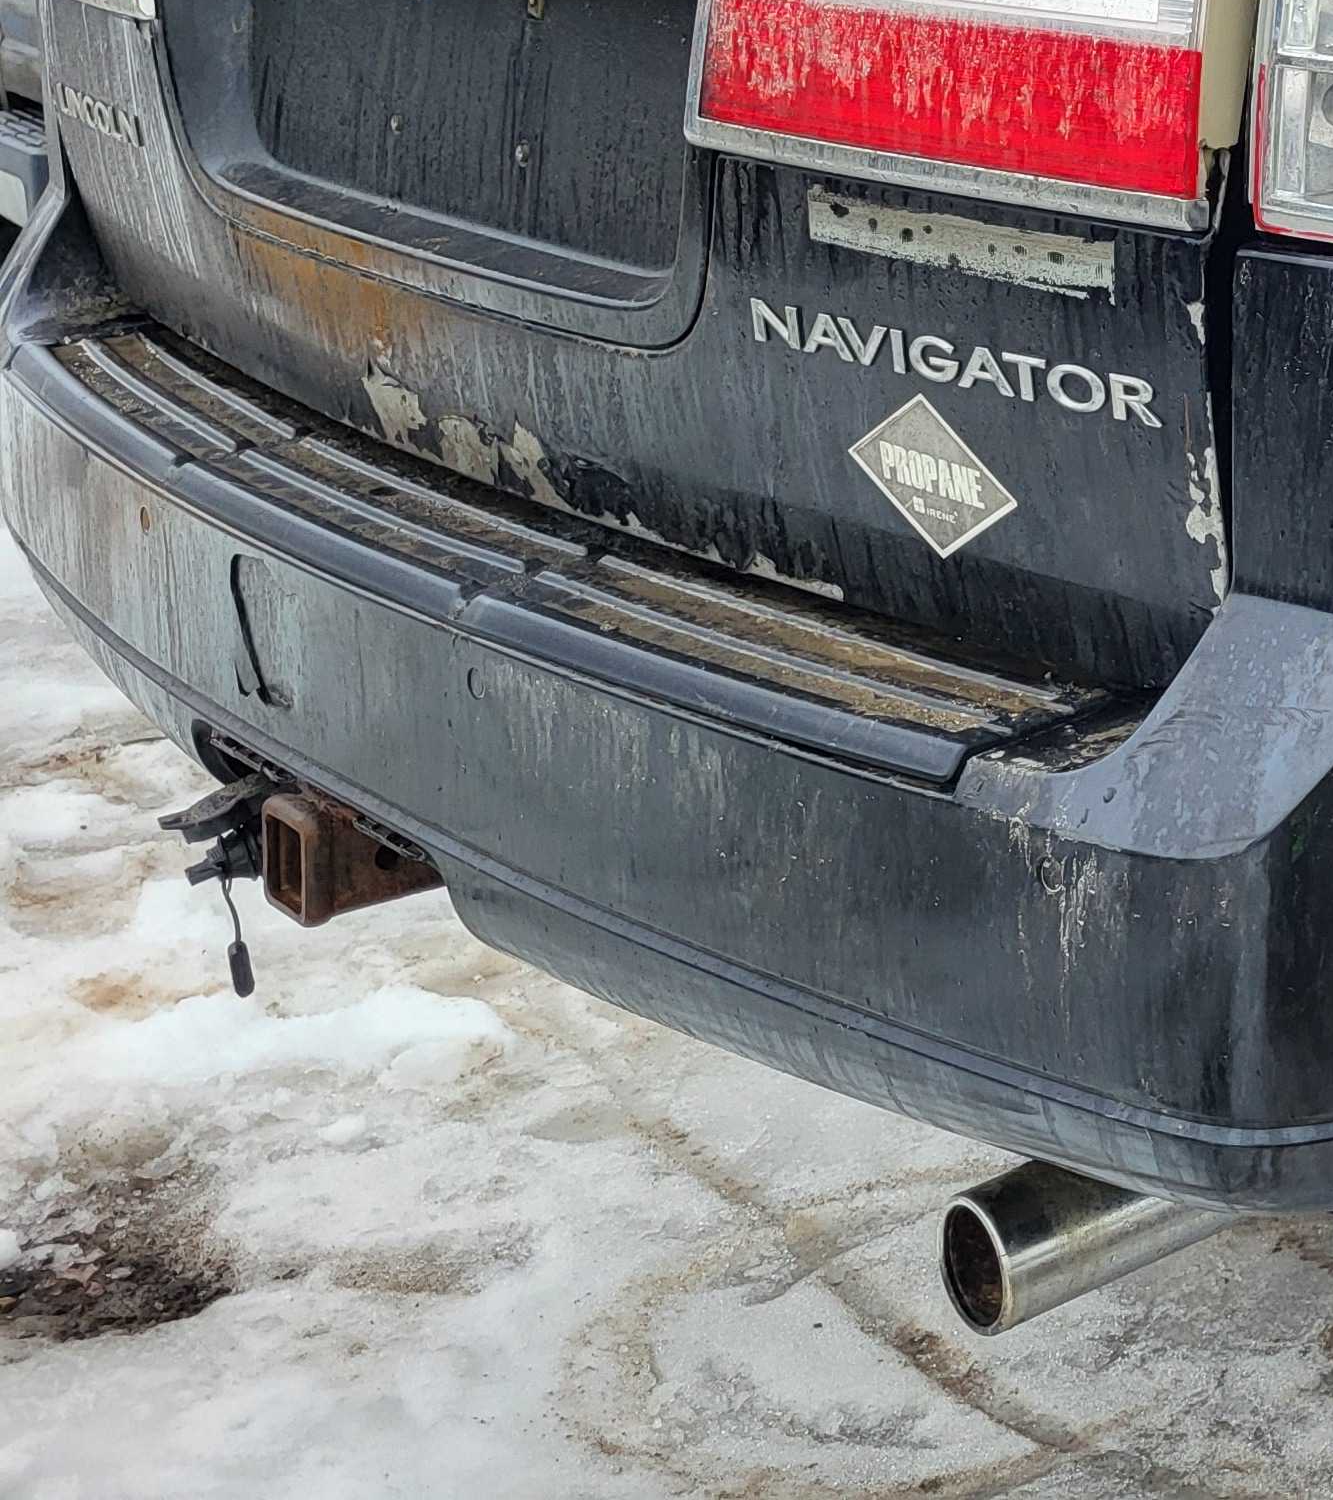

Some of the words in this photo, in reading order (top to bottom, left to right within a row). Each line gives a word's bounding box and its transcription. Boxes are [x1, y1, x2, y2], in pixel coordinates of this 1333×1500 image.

[55, 81, 146, 149] LINCOLN
[748, 296, 1163, 429] NAVIGATOR
[879, 439, 986, 511] PROPANE
